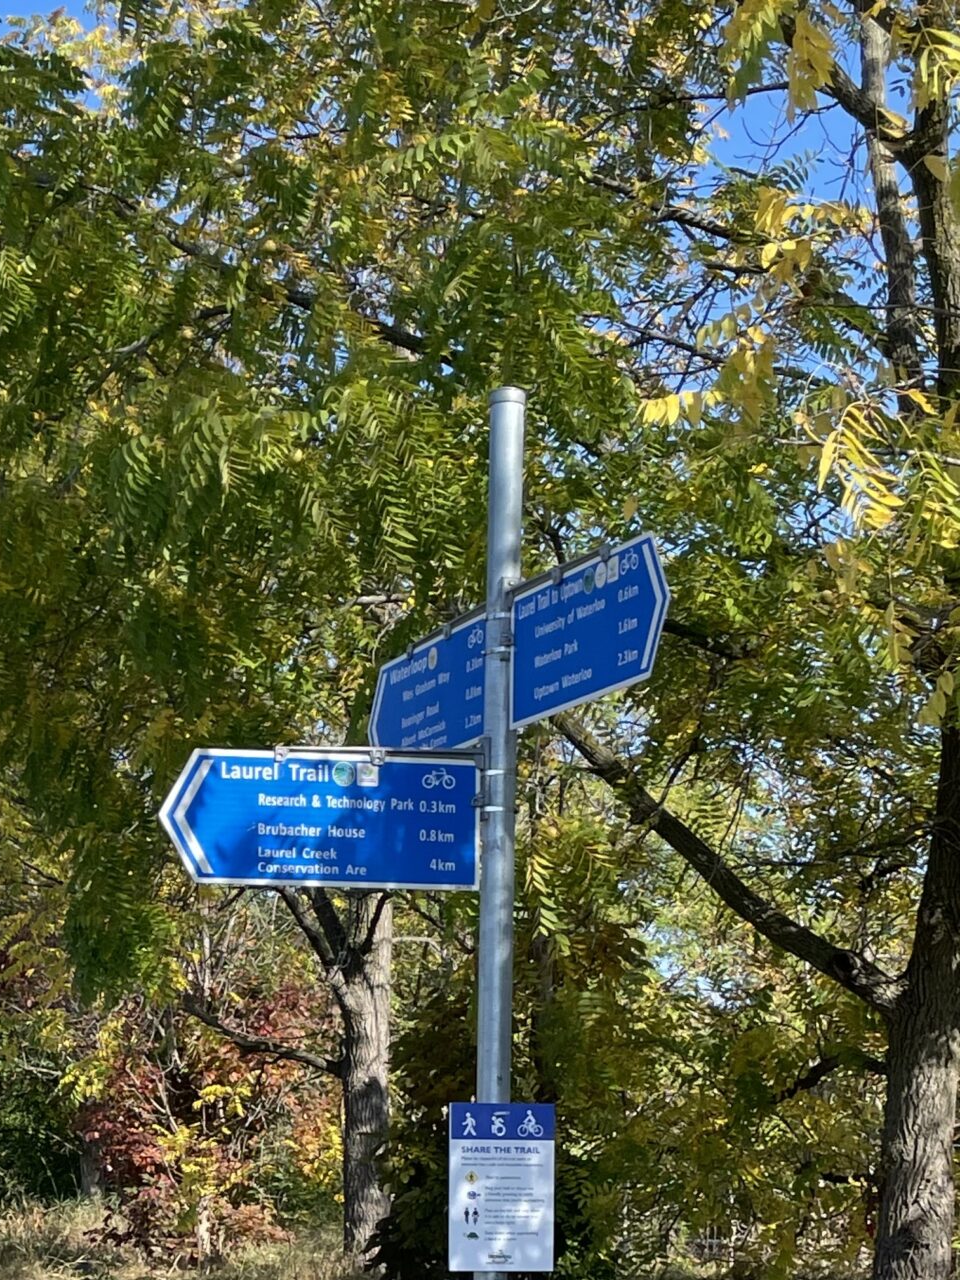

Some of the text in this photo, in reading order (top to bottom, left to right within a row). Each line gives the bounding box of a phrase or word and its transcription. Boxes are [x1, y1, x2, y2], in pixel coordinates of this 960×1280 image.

[518, 577, 583, 620] Laurel Trail to Uptown
[534, 598, 606, 638] University of Waterloo
[534, 639, 578, 668] Waterloo Park
[533, 668, 593, 701] Uptown Waterloo
[221, 761, 329, 782] Laurel Trail
[258, 793, 414, 812] Research & Technology Park
[258, 823, 366, 839] Brubacher House
[258, 846, 337, 860] Laurel Creek
[257, 862, 367, 875] Conservation Are
[461, 1146, 540, 1154] SHARE THE TRAIL
